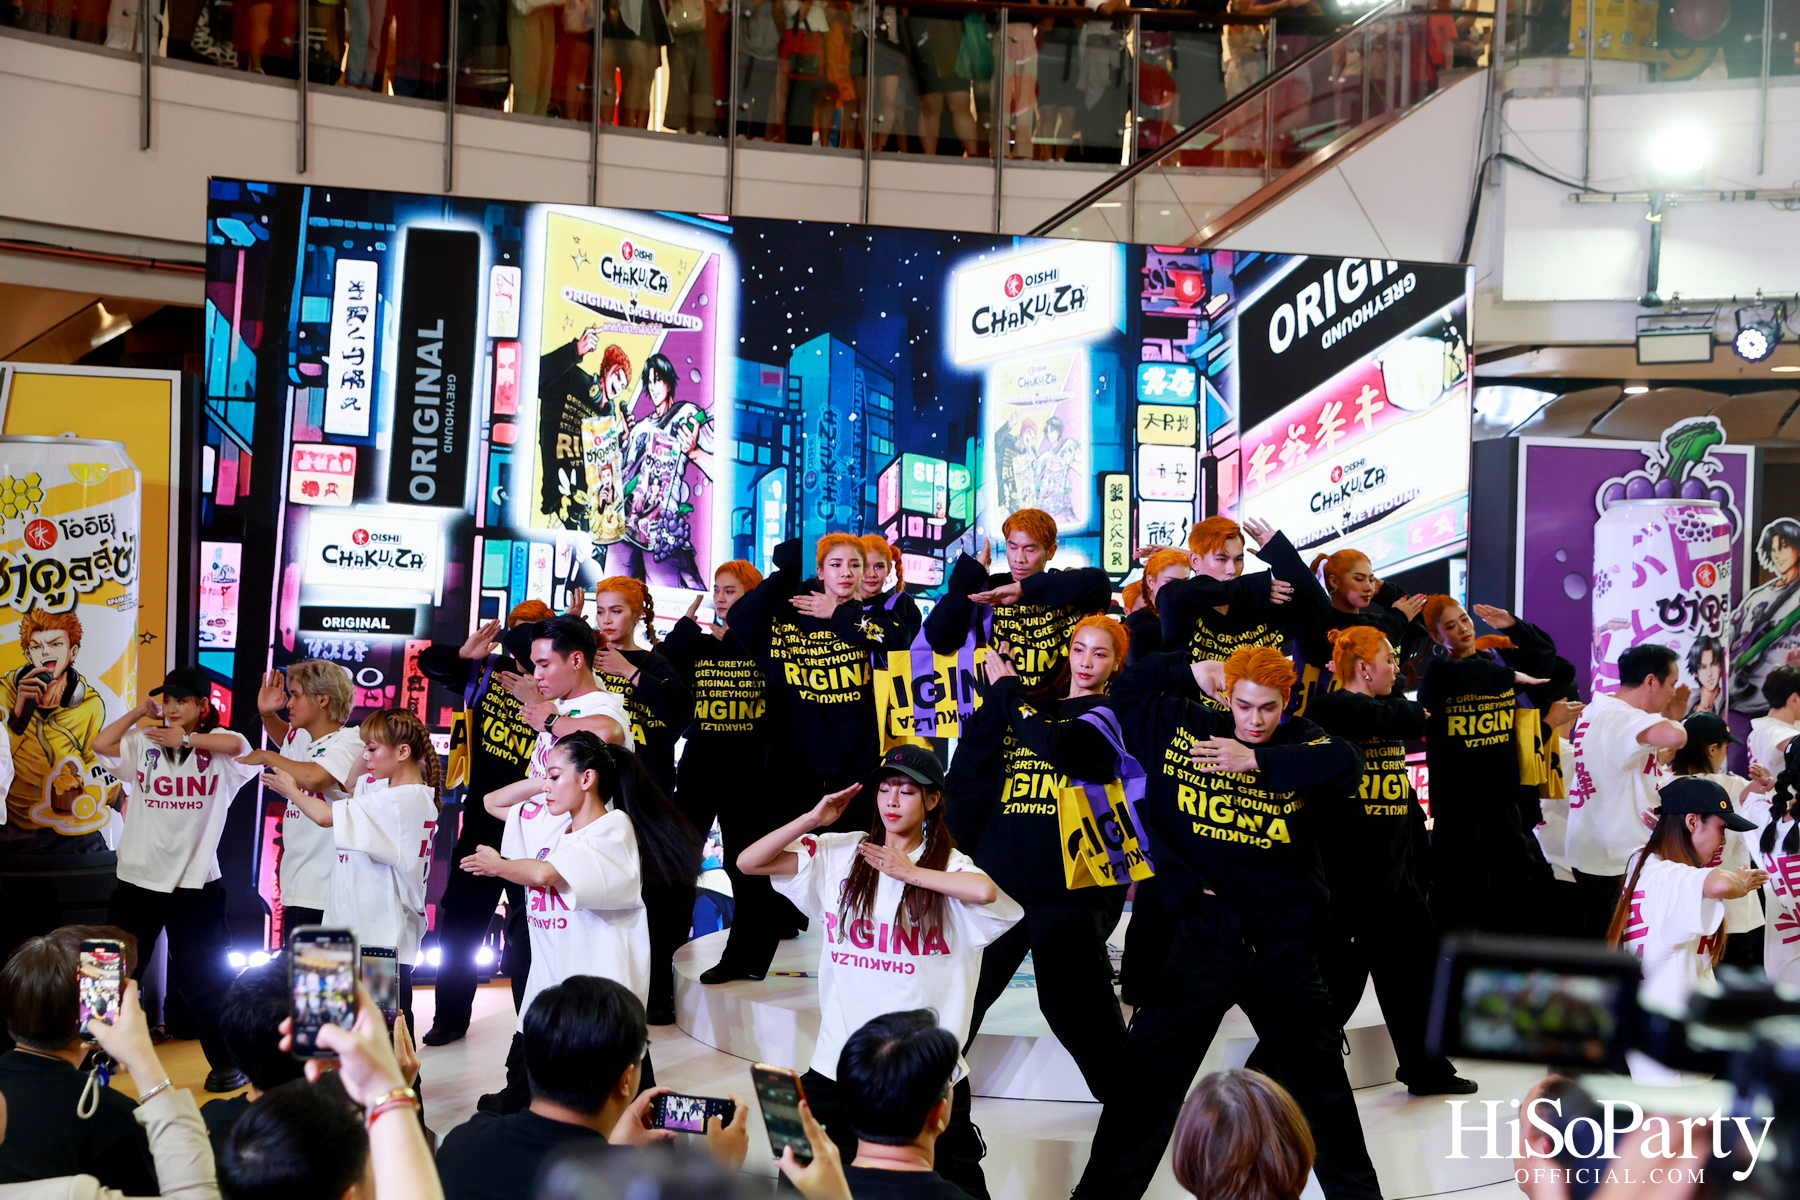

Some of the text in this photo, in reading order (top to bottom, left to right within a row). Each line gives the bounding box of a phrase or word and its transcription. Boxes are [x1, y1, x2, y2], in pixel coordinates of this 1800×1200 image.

[633, 249, 653, 260] OISHI
[1025, 269, 1057, 287] OISHI
[563, 289, 625, 313] ORIGINAL
[628, 304, 702, 329] GREYHOUND
[1321, 272, 1416, 349] GREYHOUND
[409, 319, 444, 501] ORIGINAL
[443, 373, 457, 454] GREYHOUND
[1340, 487, 1421, 529] GREYHOUND
[371, 533, 399, 543] OISHI
[322, 616, 391, 630] ORIGINAL
[695, 669, 751, 677] GREYHOUND
[799, 690, 861, 704] CHAKULZA
[1165, 749, 1192, 767] BUT
[1163, 764, 1174, 776] IS
[1177, 768, 1207, 788] STILL
[1192, 821, 1273, 849] CHAKULZA
[831, 950, 916, 975] CHAKULZA
